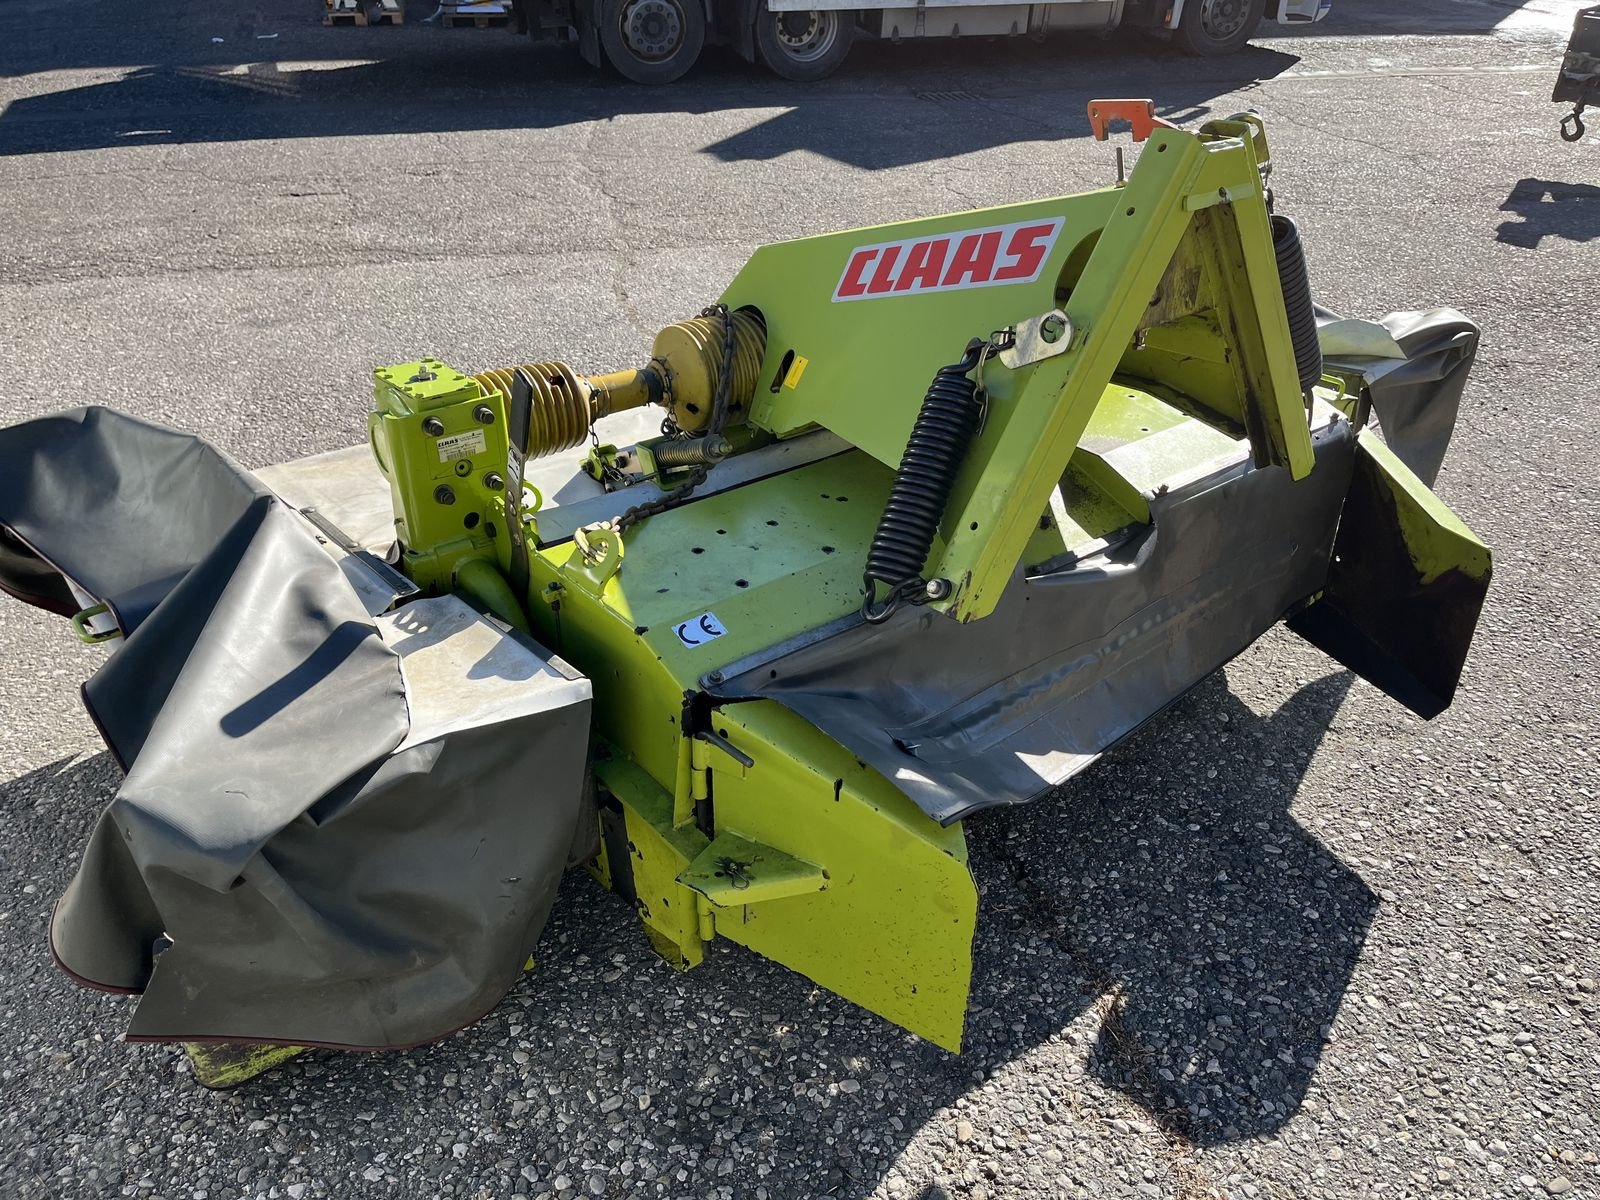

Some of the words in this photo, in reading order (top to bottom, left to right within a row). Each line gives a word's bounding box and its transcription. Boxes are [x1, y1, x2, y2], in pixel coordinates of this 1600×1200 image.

[837, 223, 1056, 297] CLAAS
[438, 438, 459, 447] CLAAS
[678, 614, 722, 645] CE
